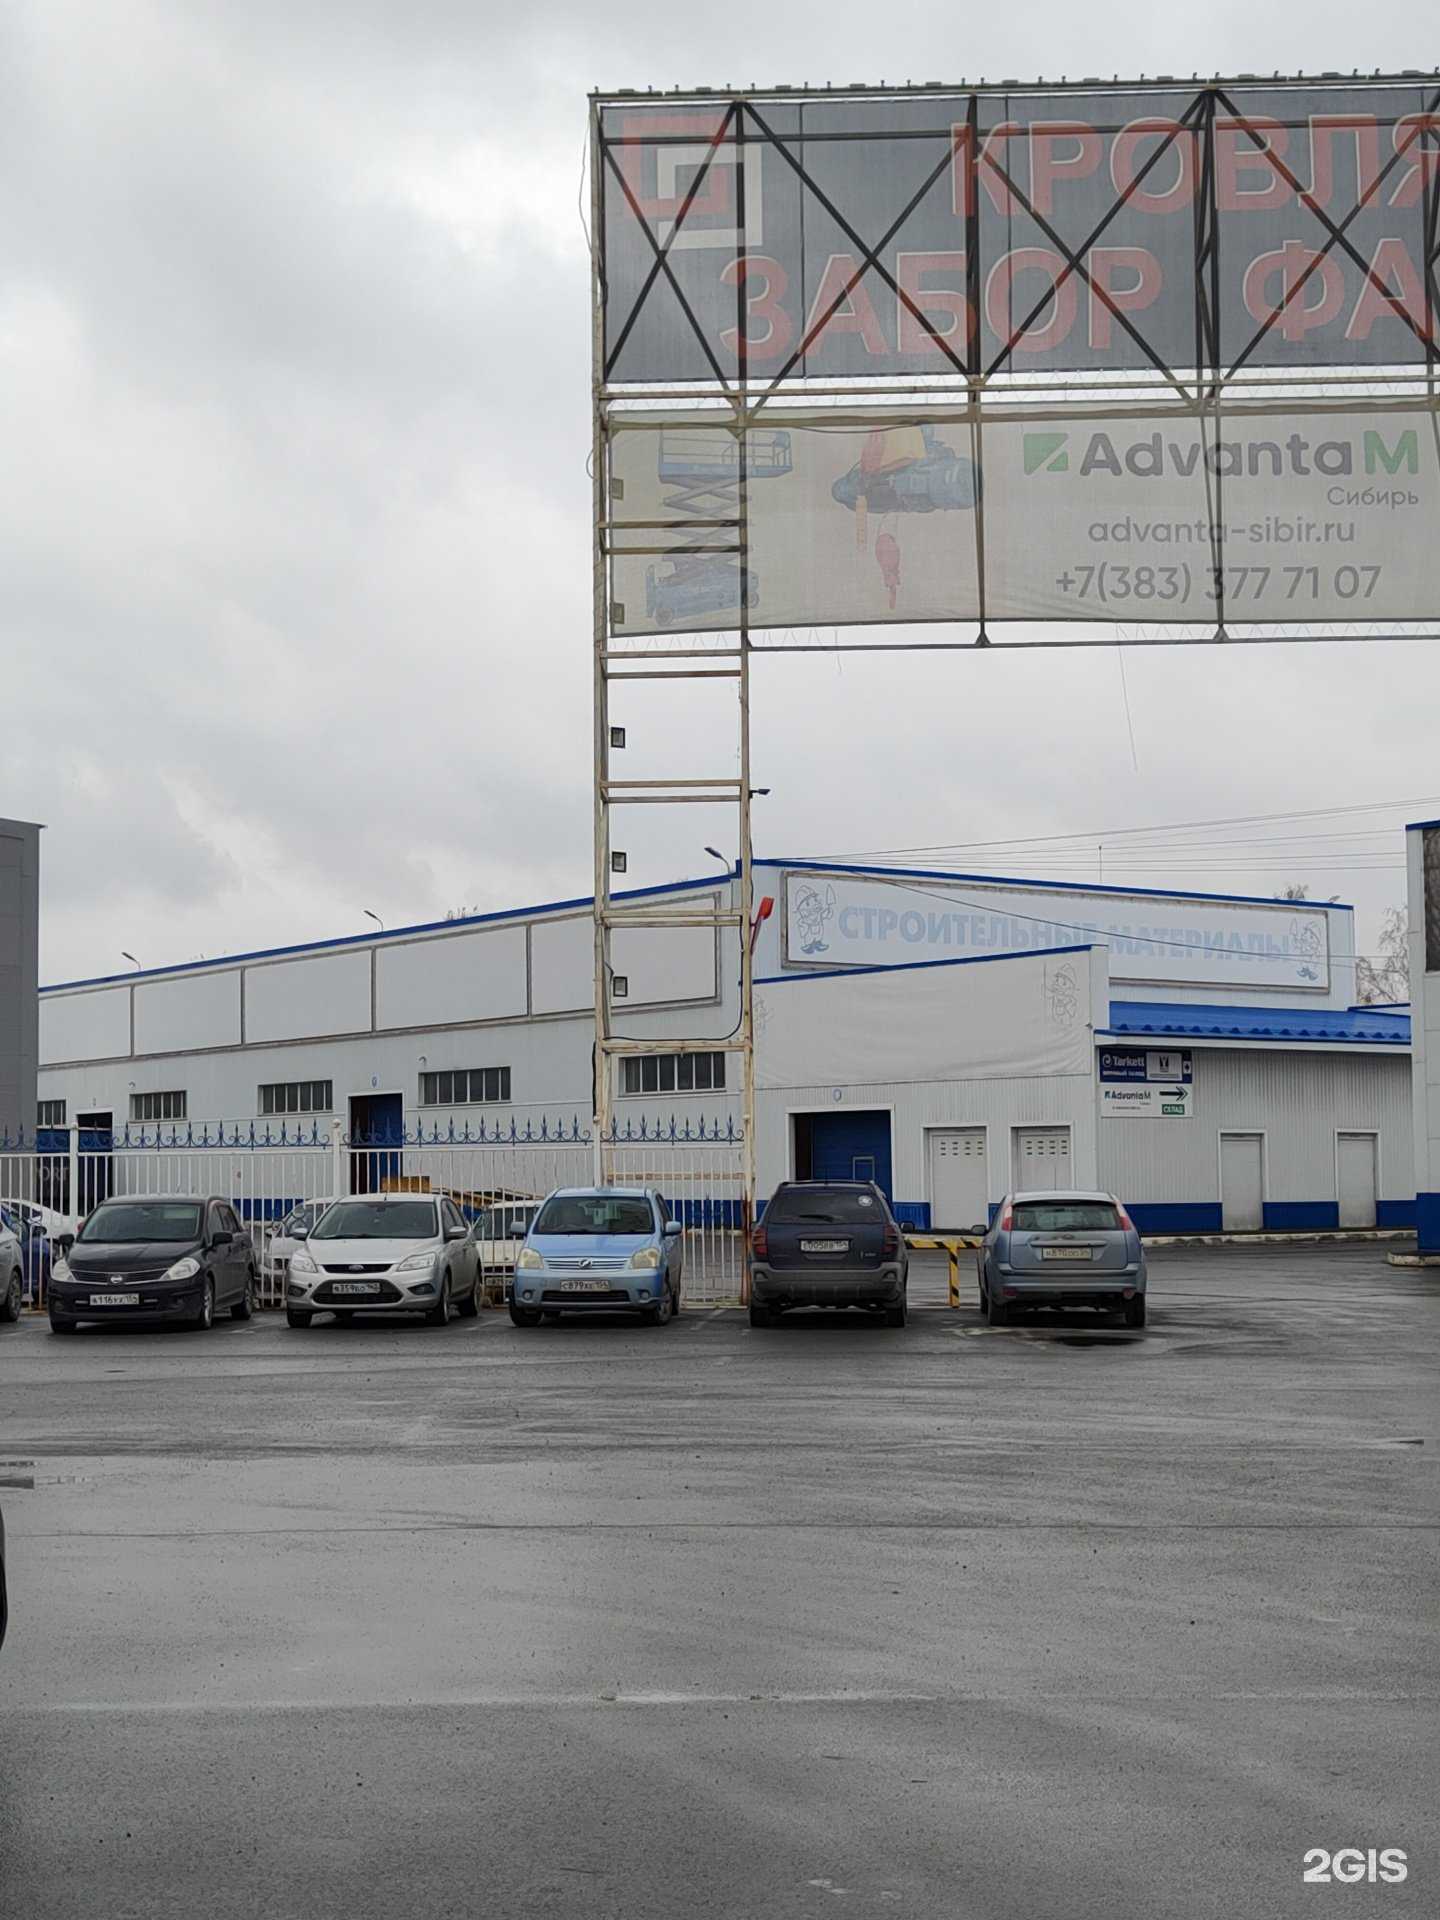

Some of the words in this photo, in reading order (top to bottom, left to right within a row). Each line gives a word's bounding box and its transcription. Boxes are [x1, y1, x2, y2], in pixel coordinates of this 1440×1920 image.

[719, 247, 1163, 361] ЗАБОР
[1327, 486, 1419, 510] Сибирь
[1088, 516, 1355, 543] advanta-sibir.ru
[1283, 566, 1319, 598] 71
[1333, 565, 1382, 599] 07
[838, 906, 1098, 948] СТРОИТЕЛЬНЫЕ
[1107, 923, 1291, 962] МАТЕРИАЛЫ
